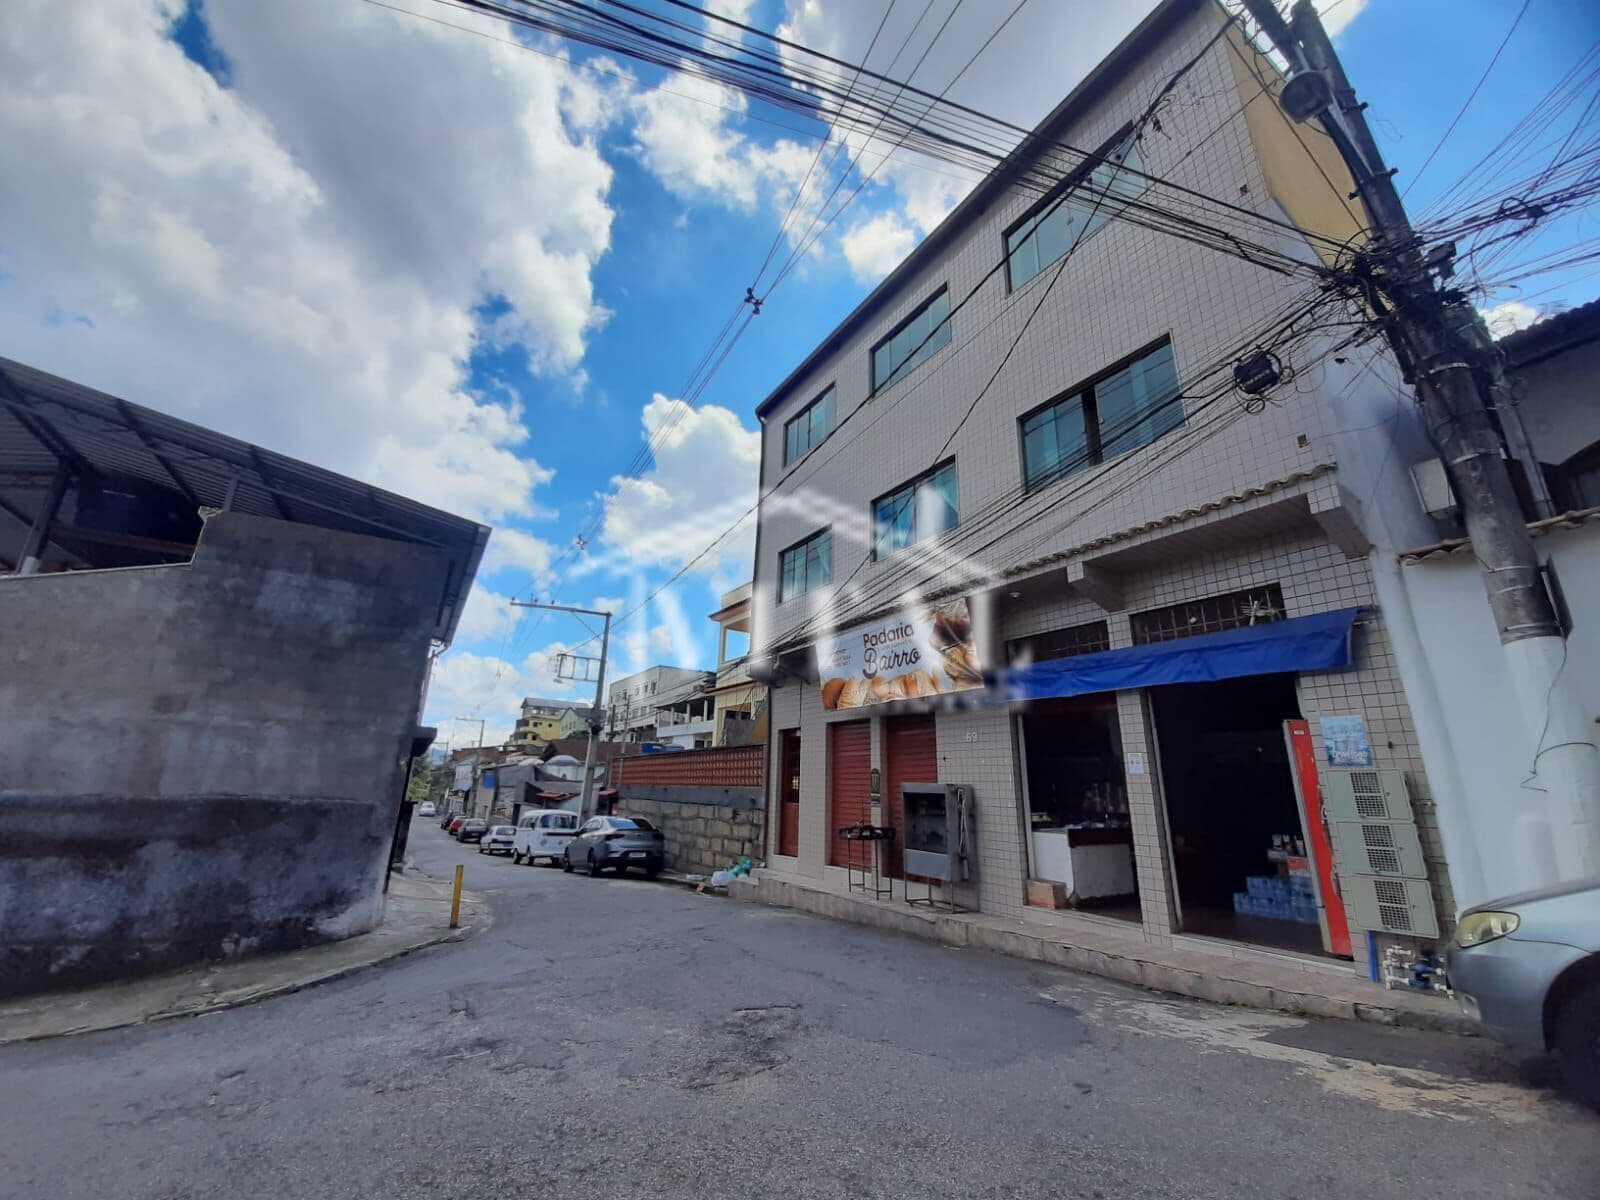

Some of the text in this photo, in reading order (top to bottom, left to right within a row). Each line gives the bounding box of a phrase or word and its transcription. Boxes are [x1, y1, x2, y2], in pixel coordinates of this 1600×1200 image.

[863, 622, 914, 648] Padaria
[862, 647, 921, 680] Bairro
[965, 732, 978, 743] 69
